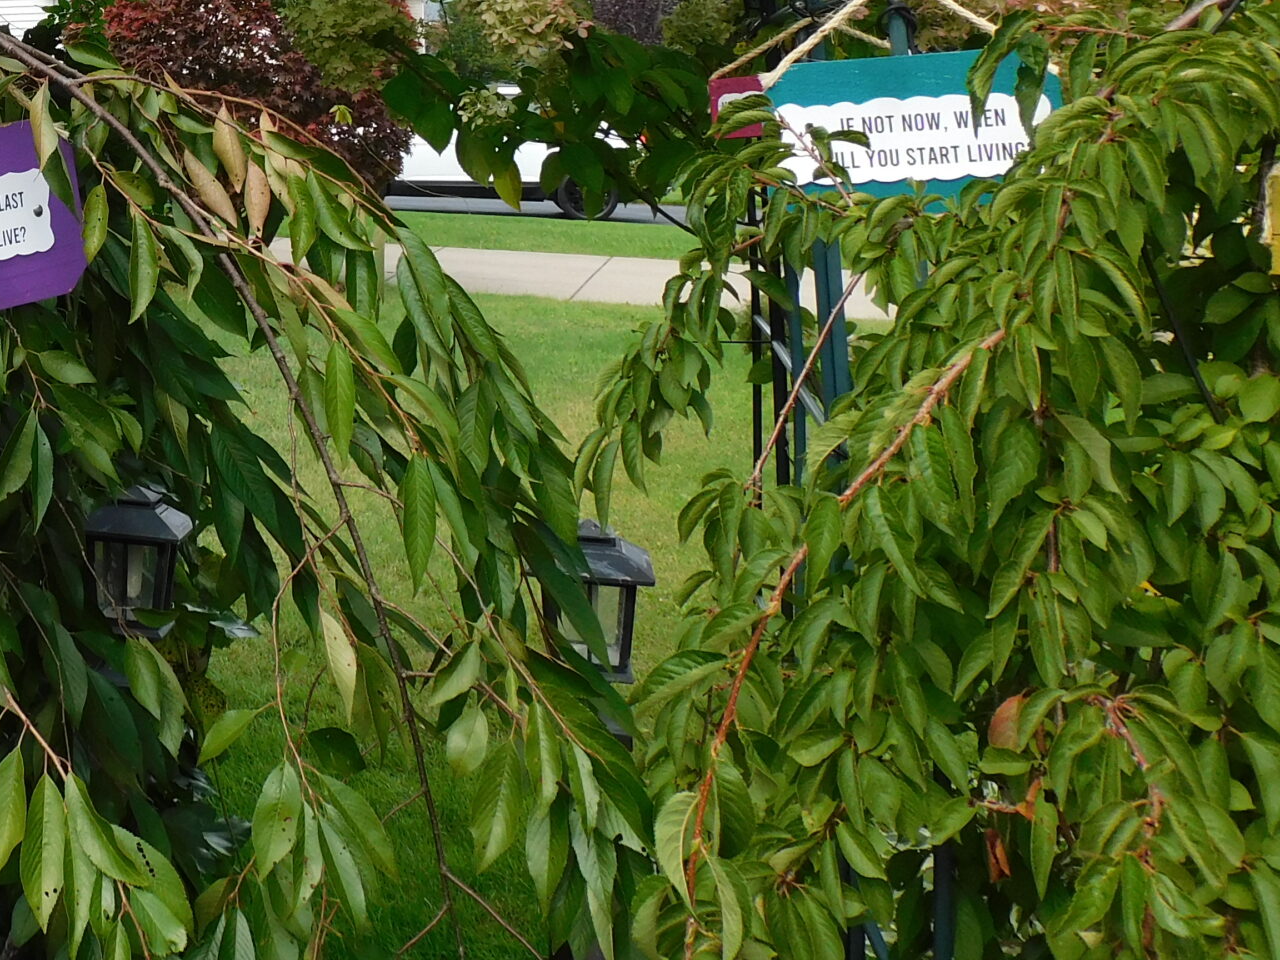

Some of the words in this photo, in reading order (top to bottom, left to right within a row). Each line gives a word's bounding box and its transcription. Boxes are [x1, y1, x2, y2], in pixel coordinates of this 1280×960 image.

[861, 114, 894, 135] NOT
[901, 111, 949, 134] NOW,
[953, 107, 1007, 129] WEN
[865, 148, 900, 170] YOU
[907, 145, 960, 167] START
